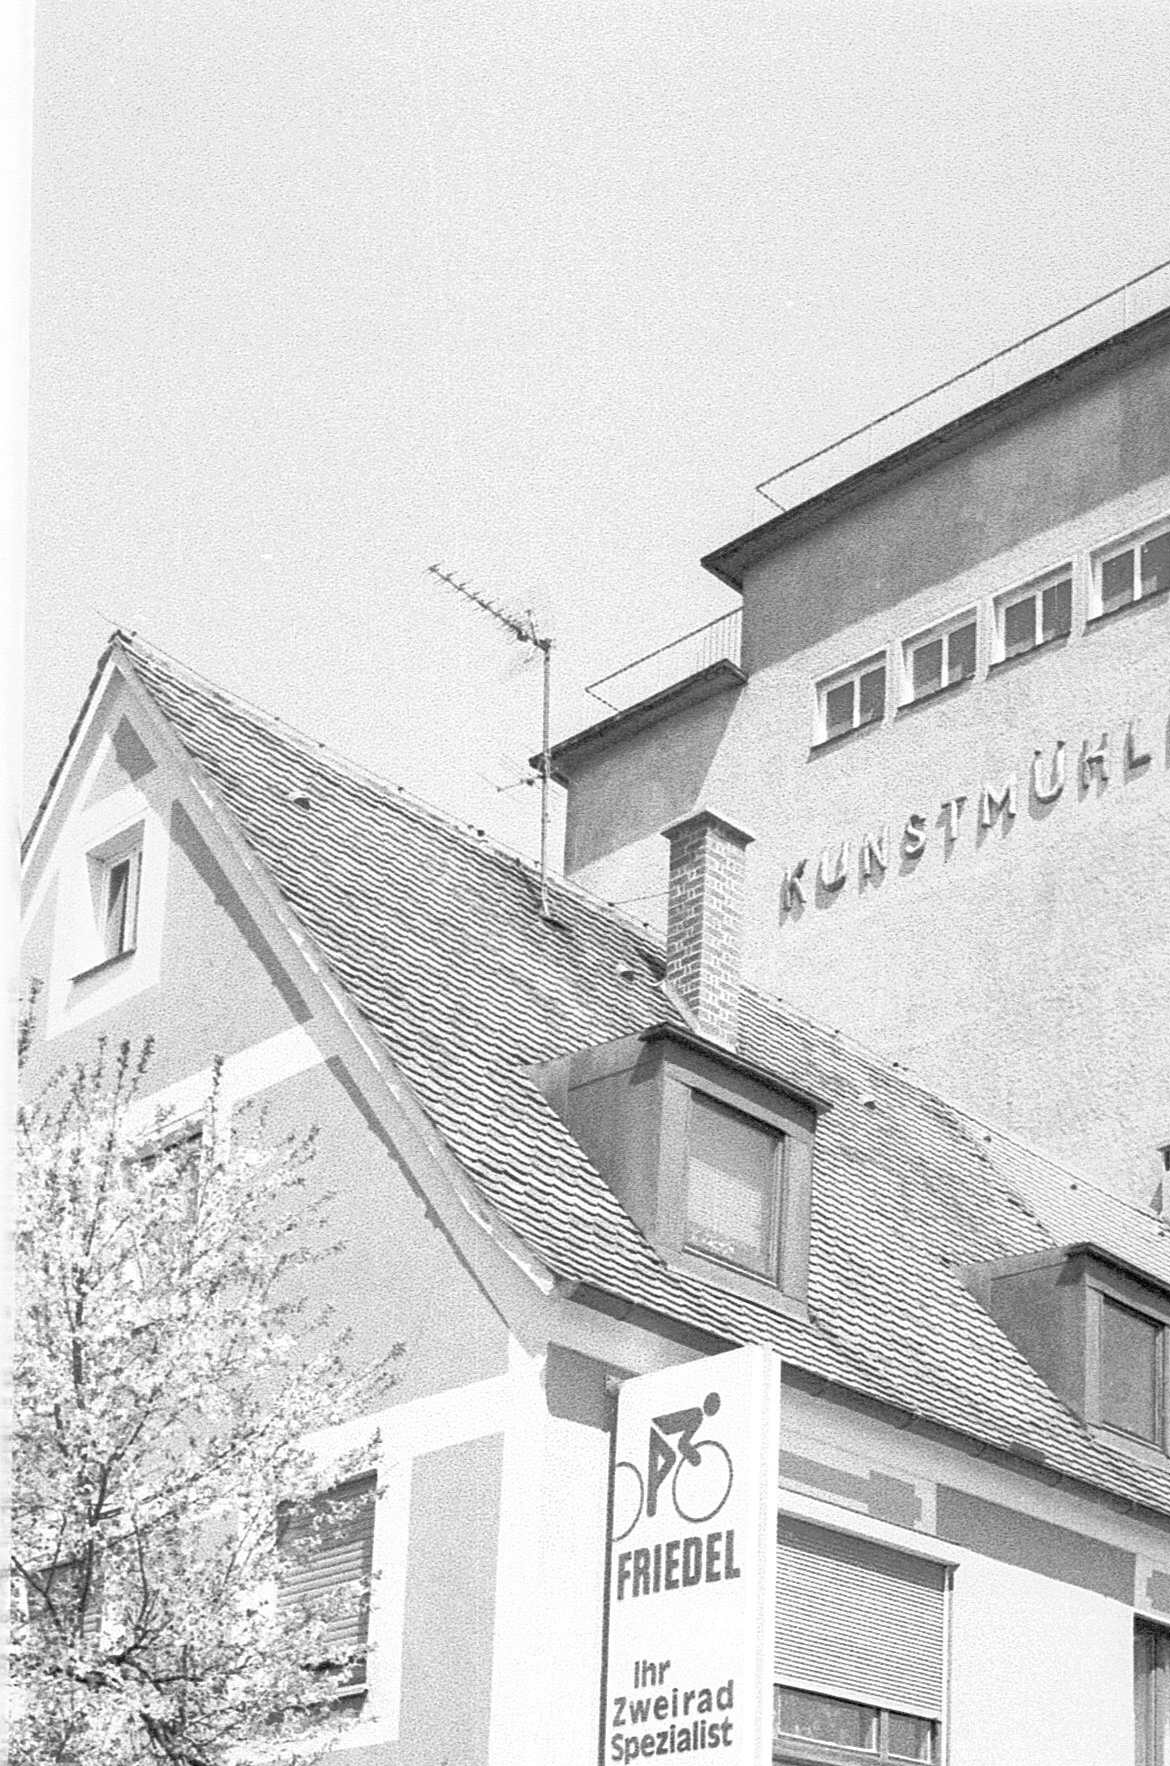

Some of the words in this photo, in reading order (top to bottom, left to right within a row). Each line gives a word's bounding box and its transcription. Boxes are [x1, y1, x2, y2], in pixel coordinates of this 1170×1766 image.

[617, 1529, 741, 1601] FRIEDEL
[633, 1659, 671, 1689] Ihr
[612, 1680, 735, 1727] Zweirad
[611, 1714, 734, 1765] Spezialist
